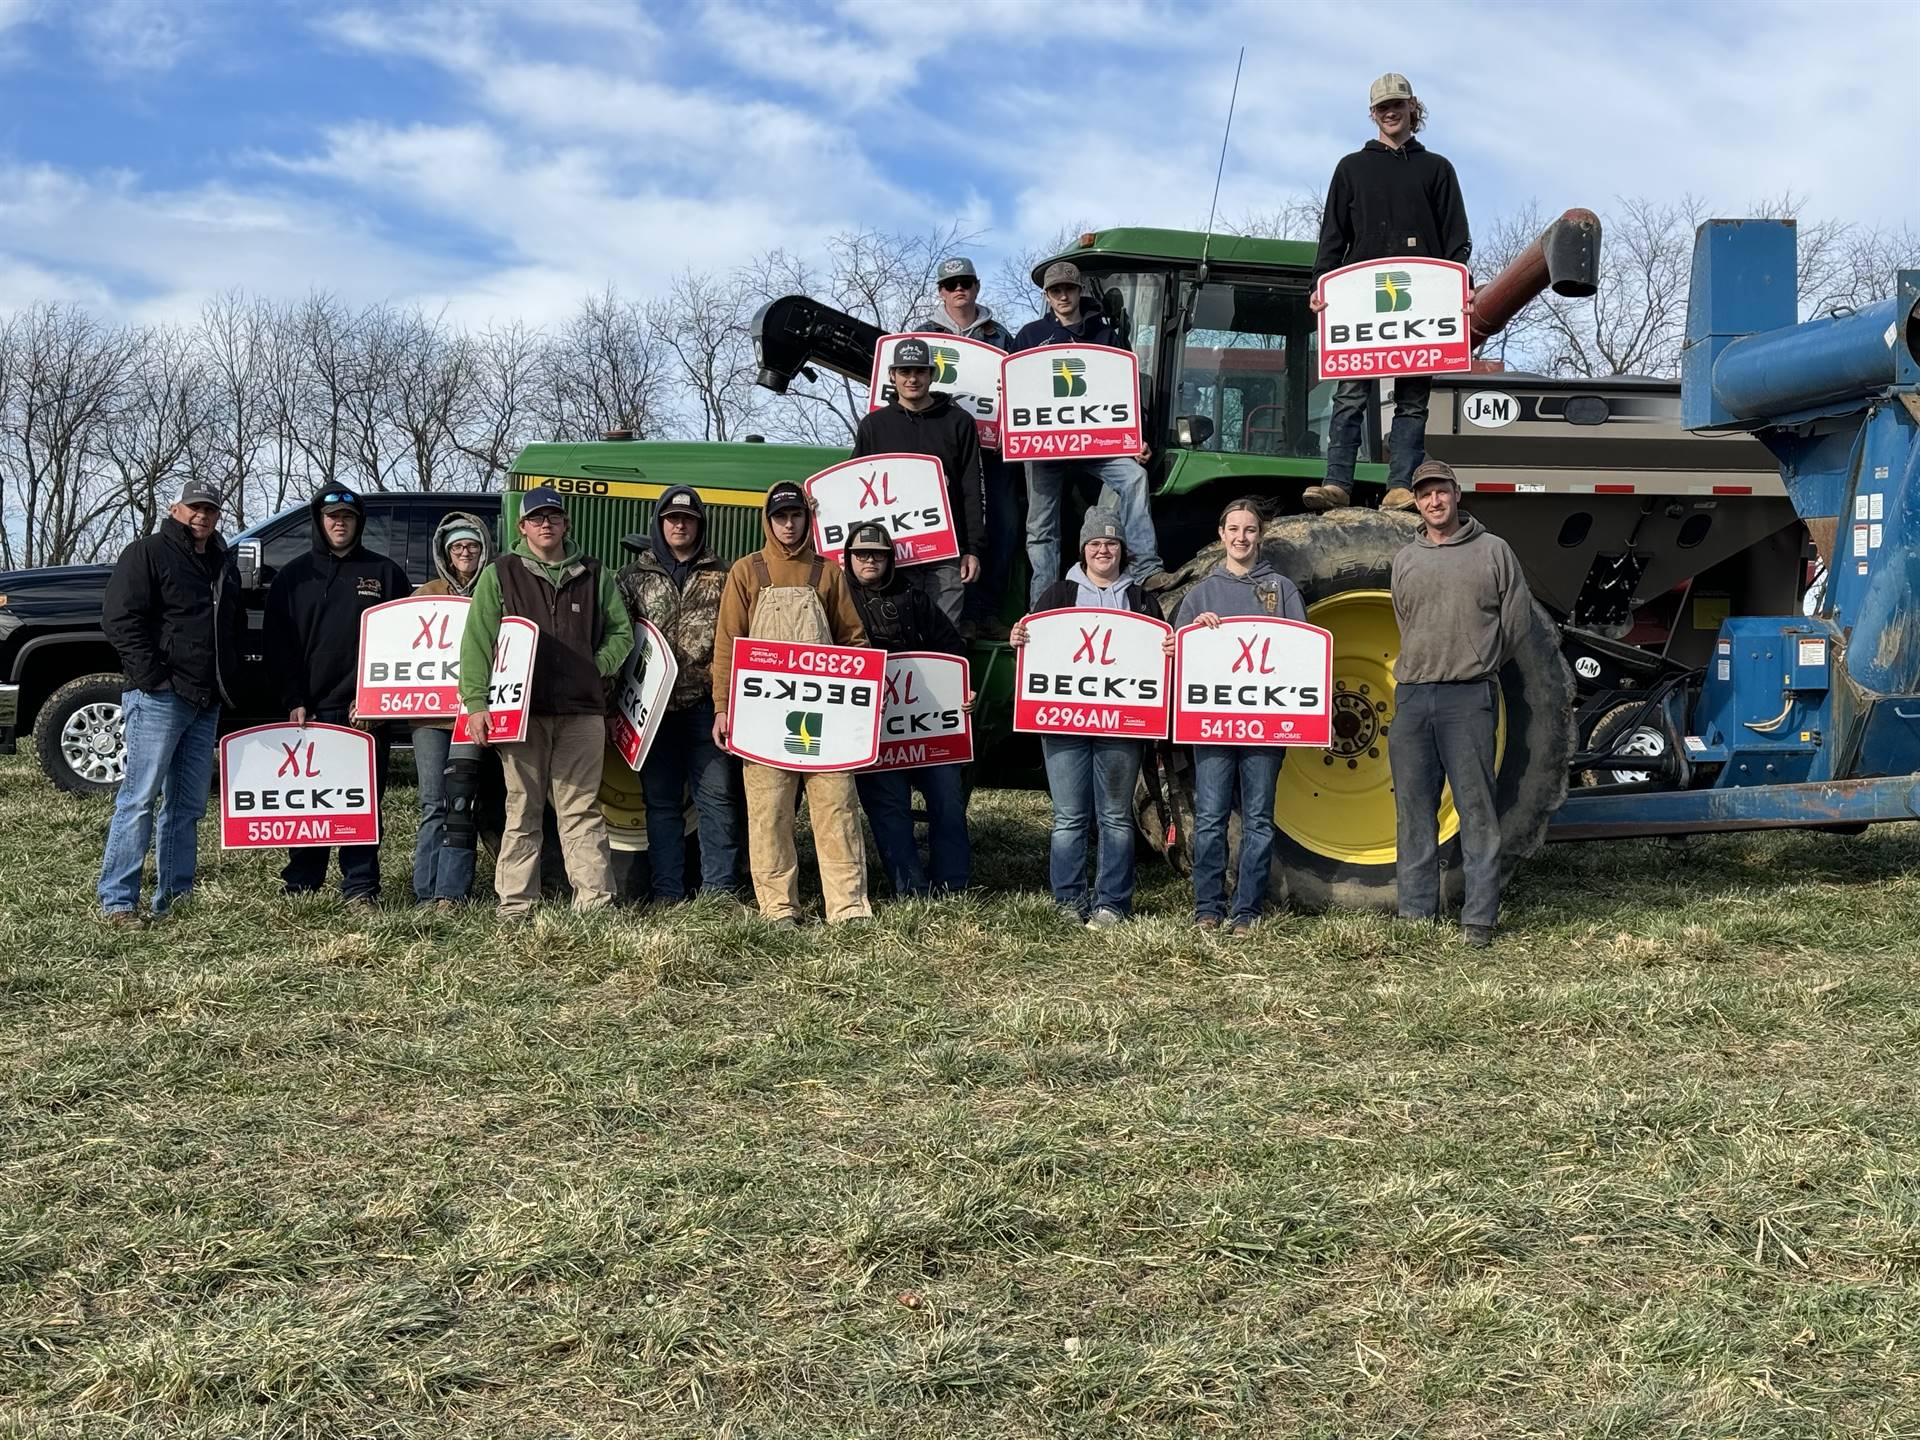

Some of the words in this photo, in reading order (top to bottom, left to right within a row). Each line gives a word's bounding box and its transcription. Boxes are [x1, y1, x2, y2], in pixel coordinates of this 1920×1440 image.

[1330, 317, 1457, 344] BECK'S
[1324, 349, 1442, 373] 6585TCV2P
[881, 384, 994, 415] B'S
[1467, 398, 1511, 420] J&M
[1013, 404, 1129, 426] BECK'S
[1009, 433, 1093, 454] 5794V2P
[541, 478, 609, 495] 4960
[859, 471, 898, 509] XL
[824, 507, 941, 544] BK'S
[412, 611, 453, 650] XL
[1073, 624, 1116, 665] XL
[1232, 633, 1275, 674] XL
[370, 661, 460, 682] BECK
[788, 649, 866, 675] 6235D1
[487, 683, 523, 705] CK'S
[743, 677, 871, 707] BECK'S
[884, 669, 919, 705] XL
[1028, 673, 1158, 700] BECK'S
[1187, 684, 1319, 707] BECK'S
[380, 692, 441, 712] 5647Q
[886, 709, 959, 735] CK'S
[1035, 706, 1120, 729] 6296AM
[1200, 718, 1265, 739] 5413Q
[278, 739, 320, 778] XL
[234, 788, 365, 811] BECK'S
[248, 820, 331, 841] 5507AM
